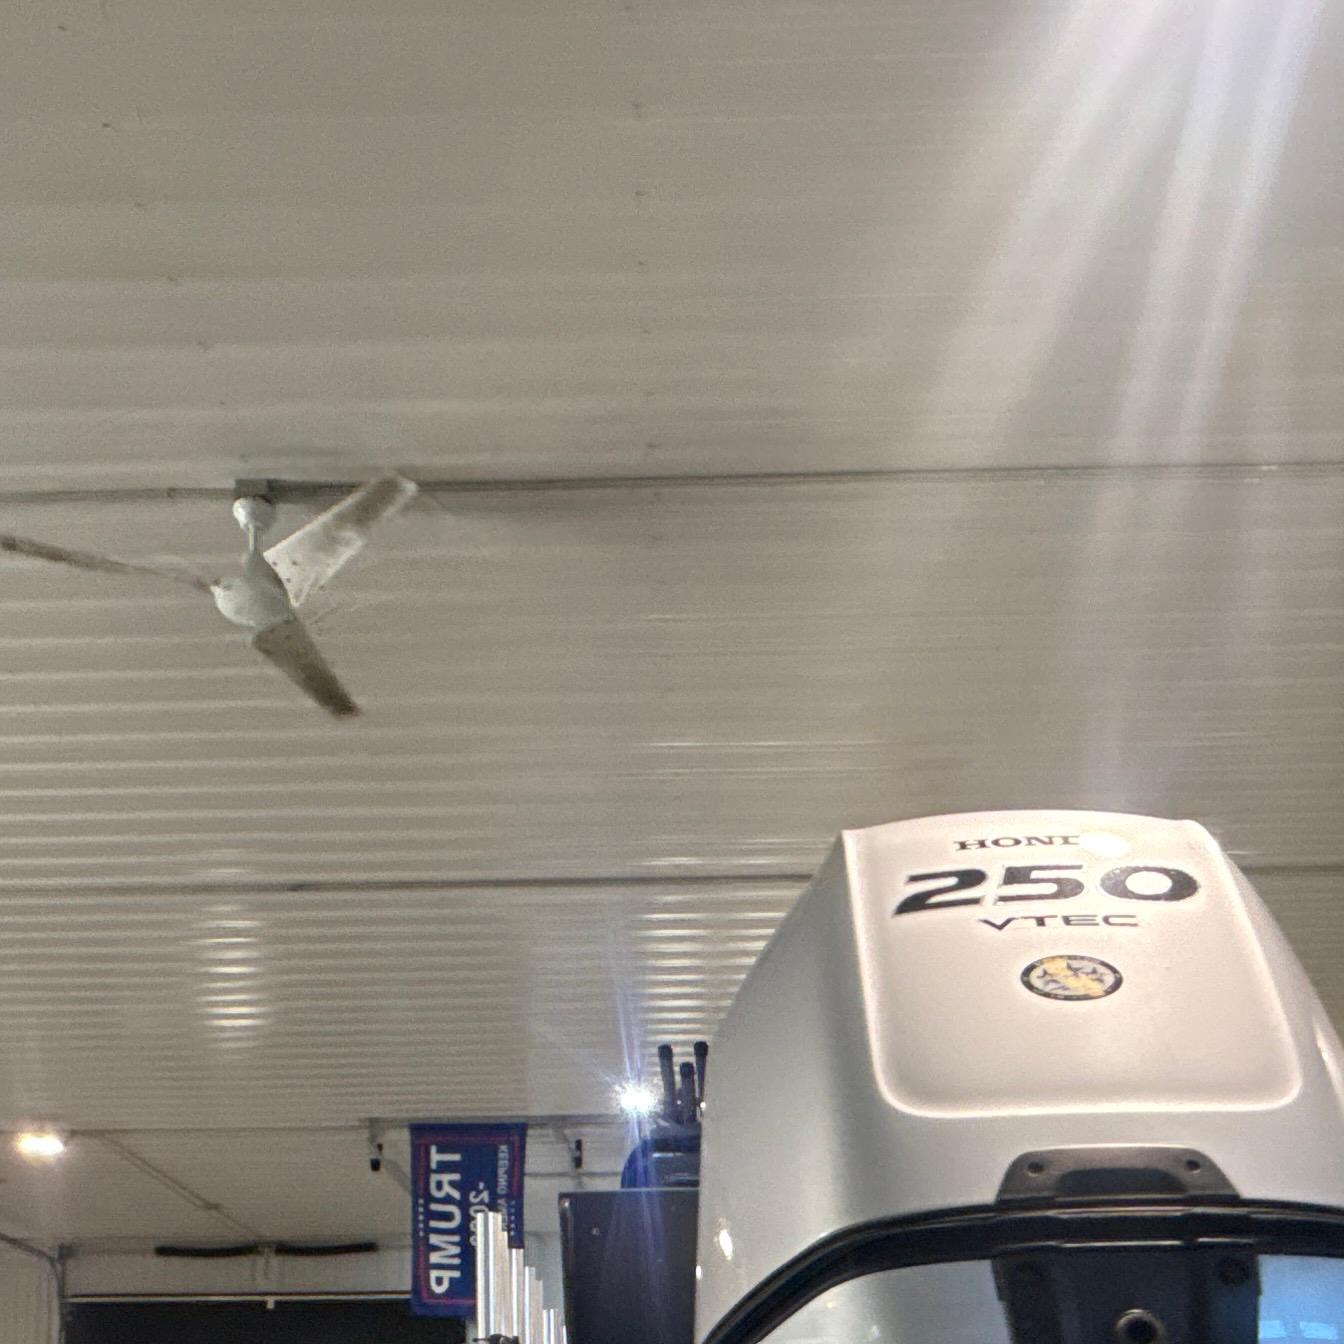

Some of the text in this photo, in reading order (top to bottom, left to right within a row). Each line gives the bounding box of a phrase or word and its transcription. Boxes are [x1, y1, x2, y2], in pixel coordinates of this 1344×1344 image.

[954, 835, 1080, 852] HON
[891, 864, 1201, 917] 250
[976, 914, 1139, 931] VTEC
